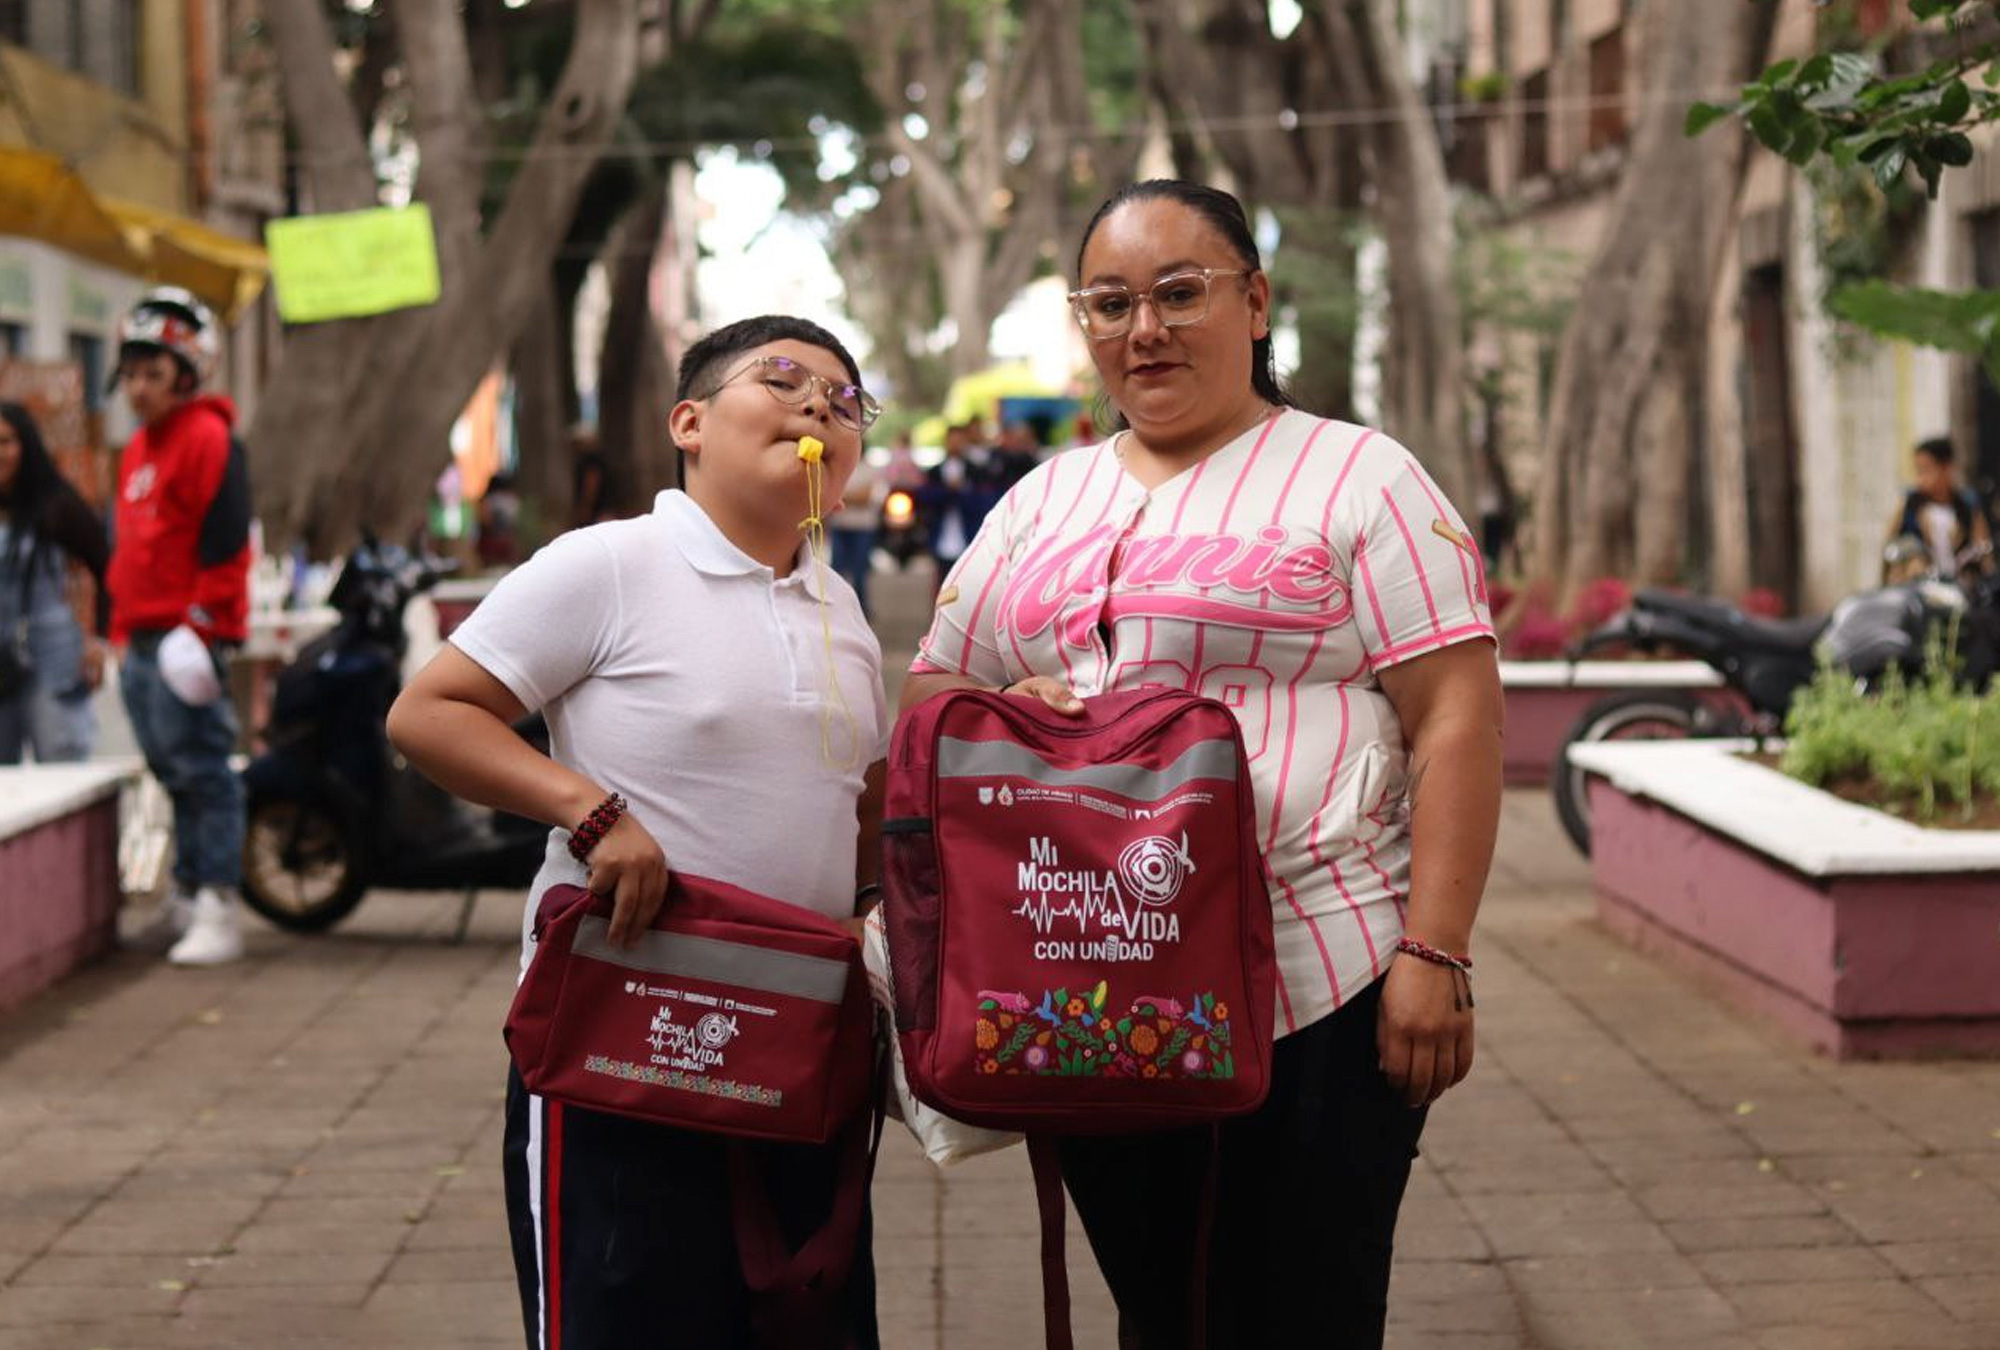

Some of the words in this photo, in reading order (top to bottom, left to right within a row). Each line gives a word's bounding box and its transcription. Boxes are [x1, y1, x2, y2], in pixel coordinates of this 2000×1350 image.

[1018, 861, 1118, 893] MOCHILA
[1101, 909, 1122, 927] de
[1123, 910, 1180, 942] VIDA
[1034, 941, 1075, 960] CON
[650, 1053, 669, 1066] CON
[691, 1049, 724, 1067] VIDA
